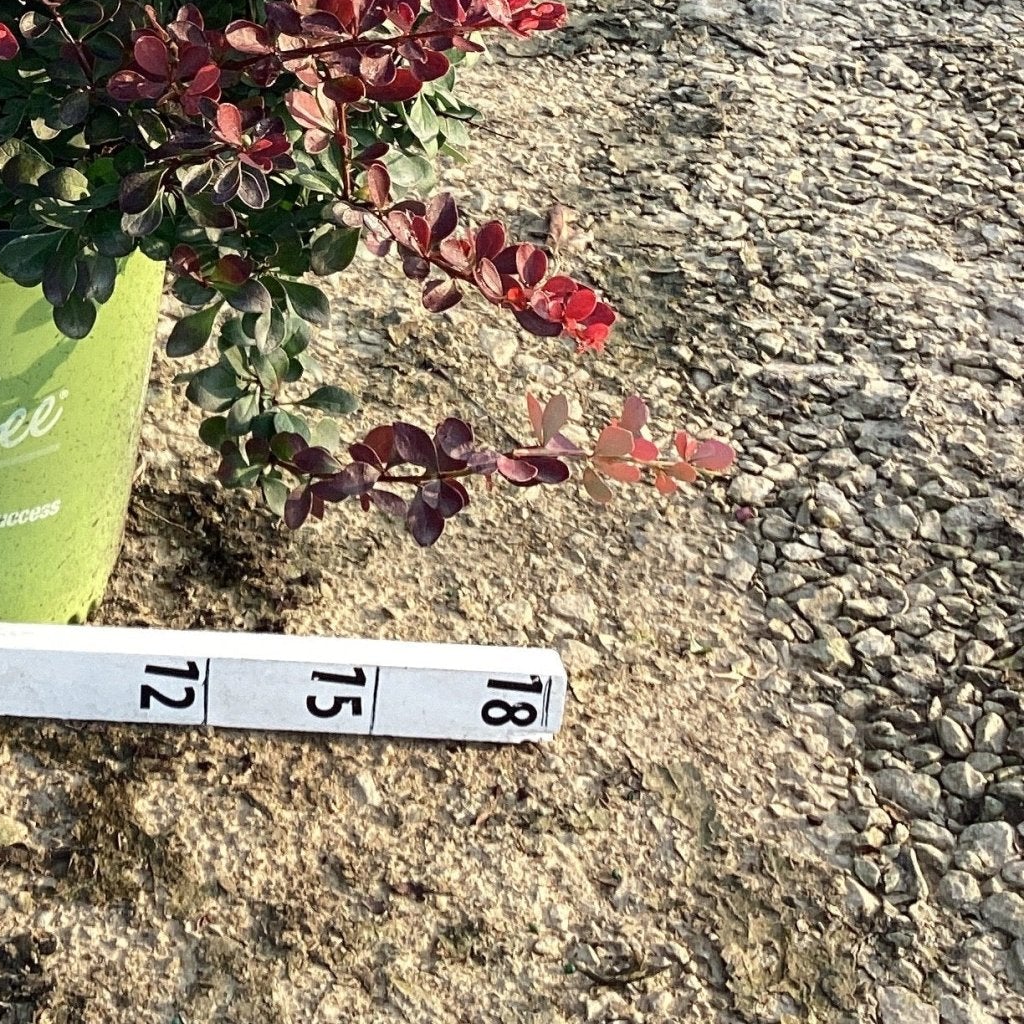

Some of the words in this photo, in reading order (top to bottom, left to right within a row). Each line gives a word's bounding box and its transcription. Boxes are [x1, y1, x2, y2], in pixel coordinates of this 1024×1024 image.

[139, 660, 200, 710] 12
[305, 666, 367, 718] 15
[480, 674, 543, 727] 18
